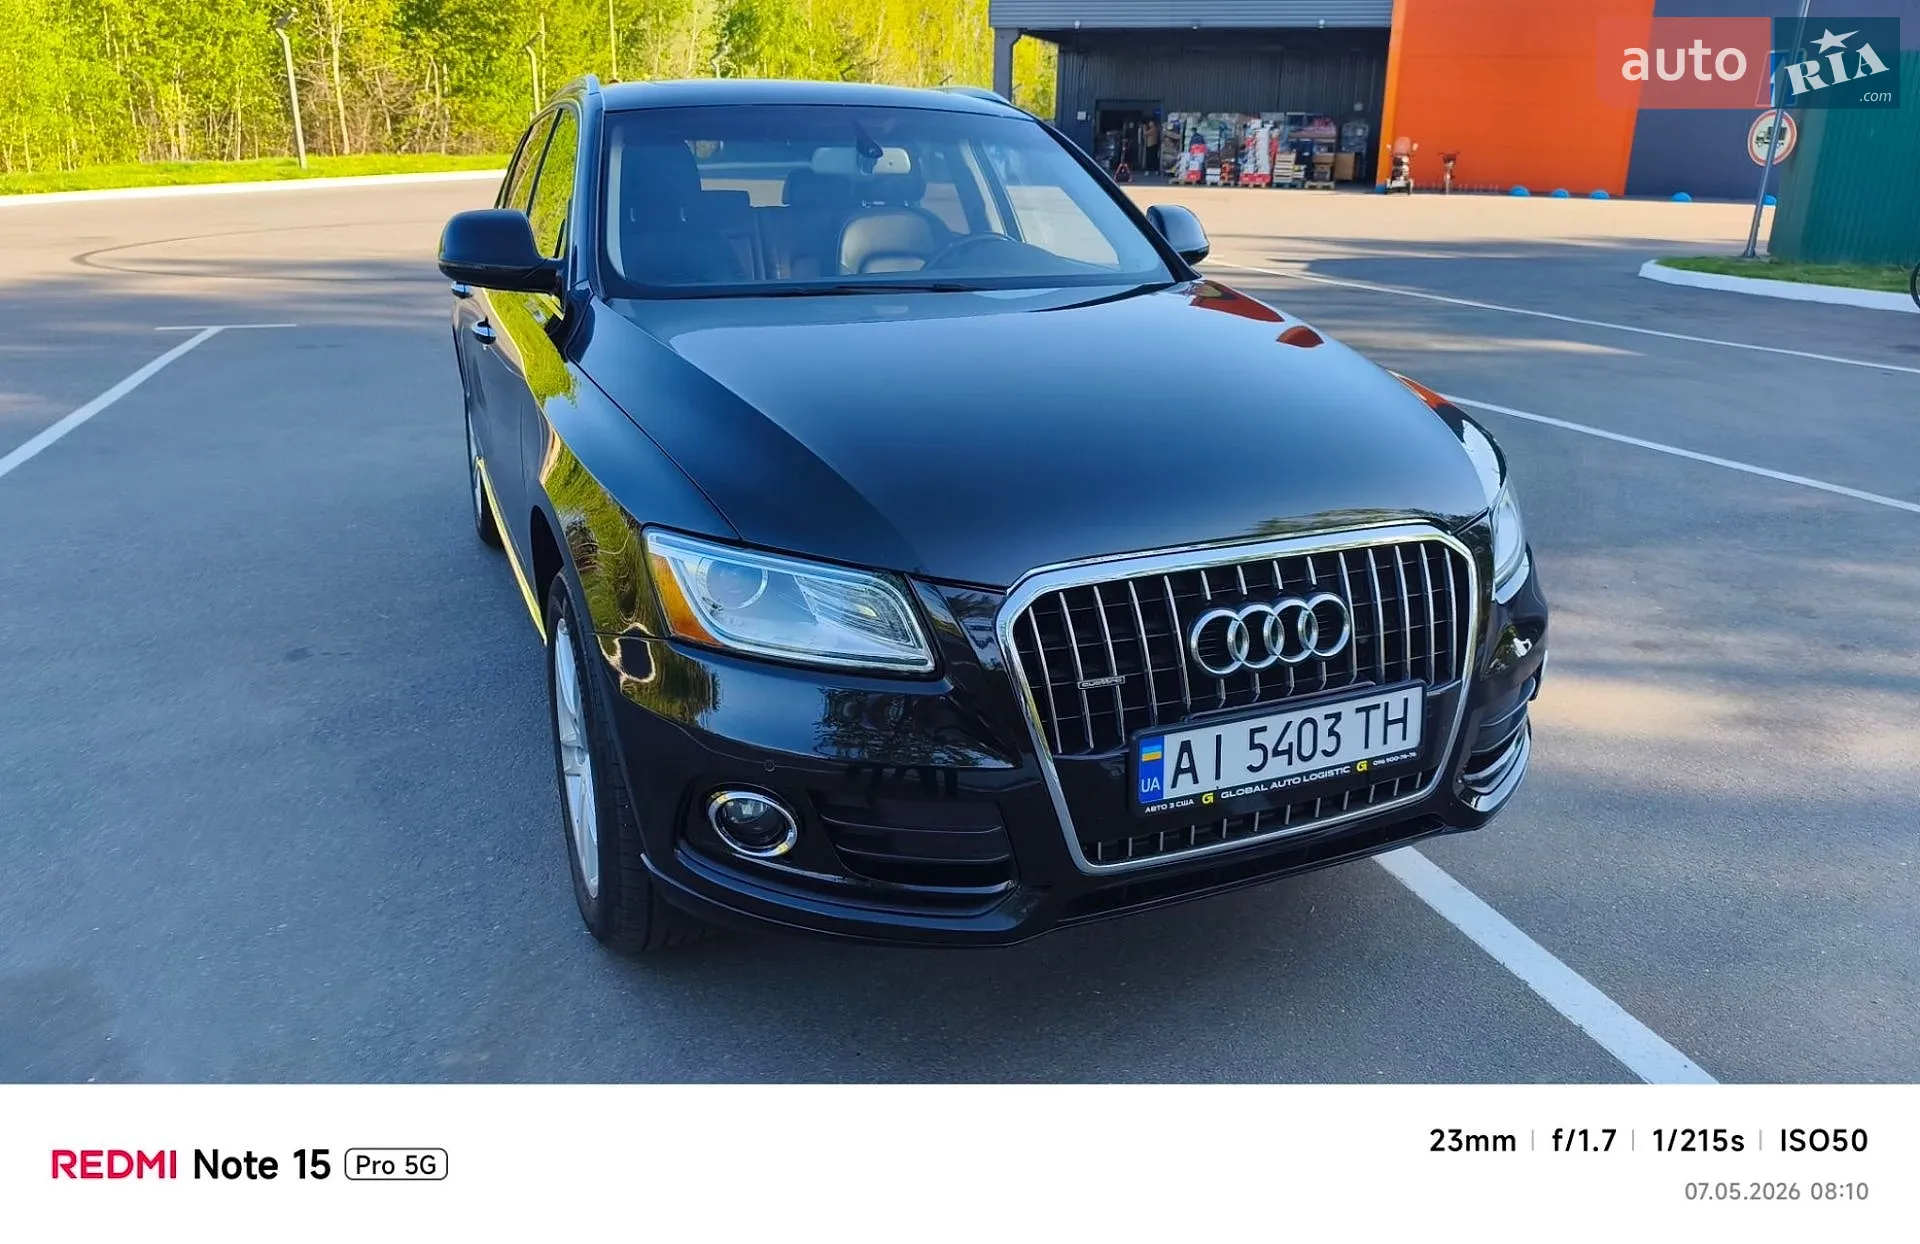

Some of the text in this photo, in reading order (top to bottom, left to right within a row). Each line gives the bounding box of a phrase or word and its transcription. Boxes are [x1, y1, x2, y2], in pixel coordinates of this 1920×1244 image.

[1170, 697, 1409, 789] AI 5403 TH
[1141, 779, 1161, 793] UA
[1220, 765, 1351, 799] GLOBAL AUTO LOGISTIC
